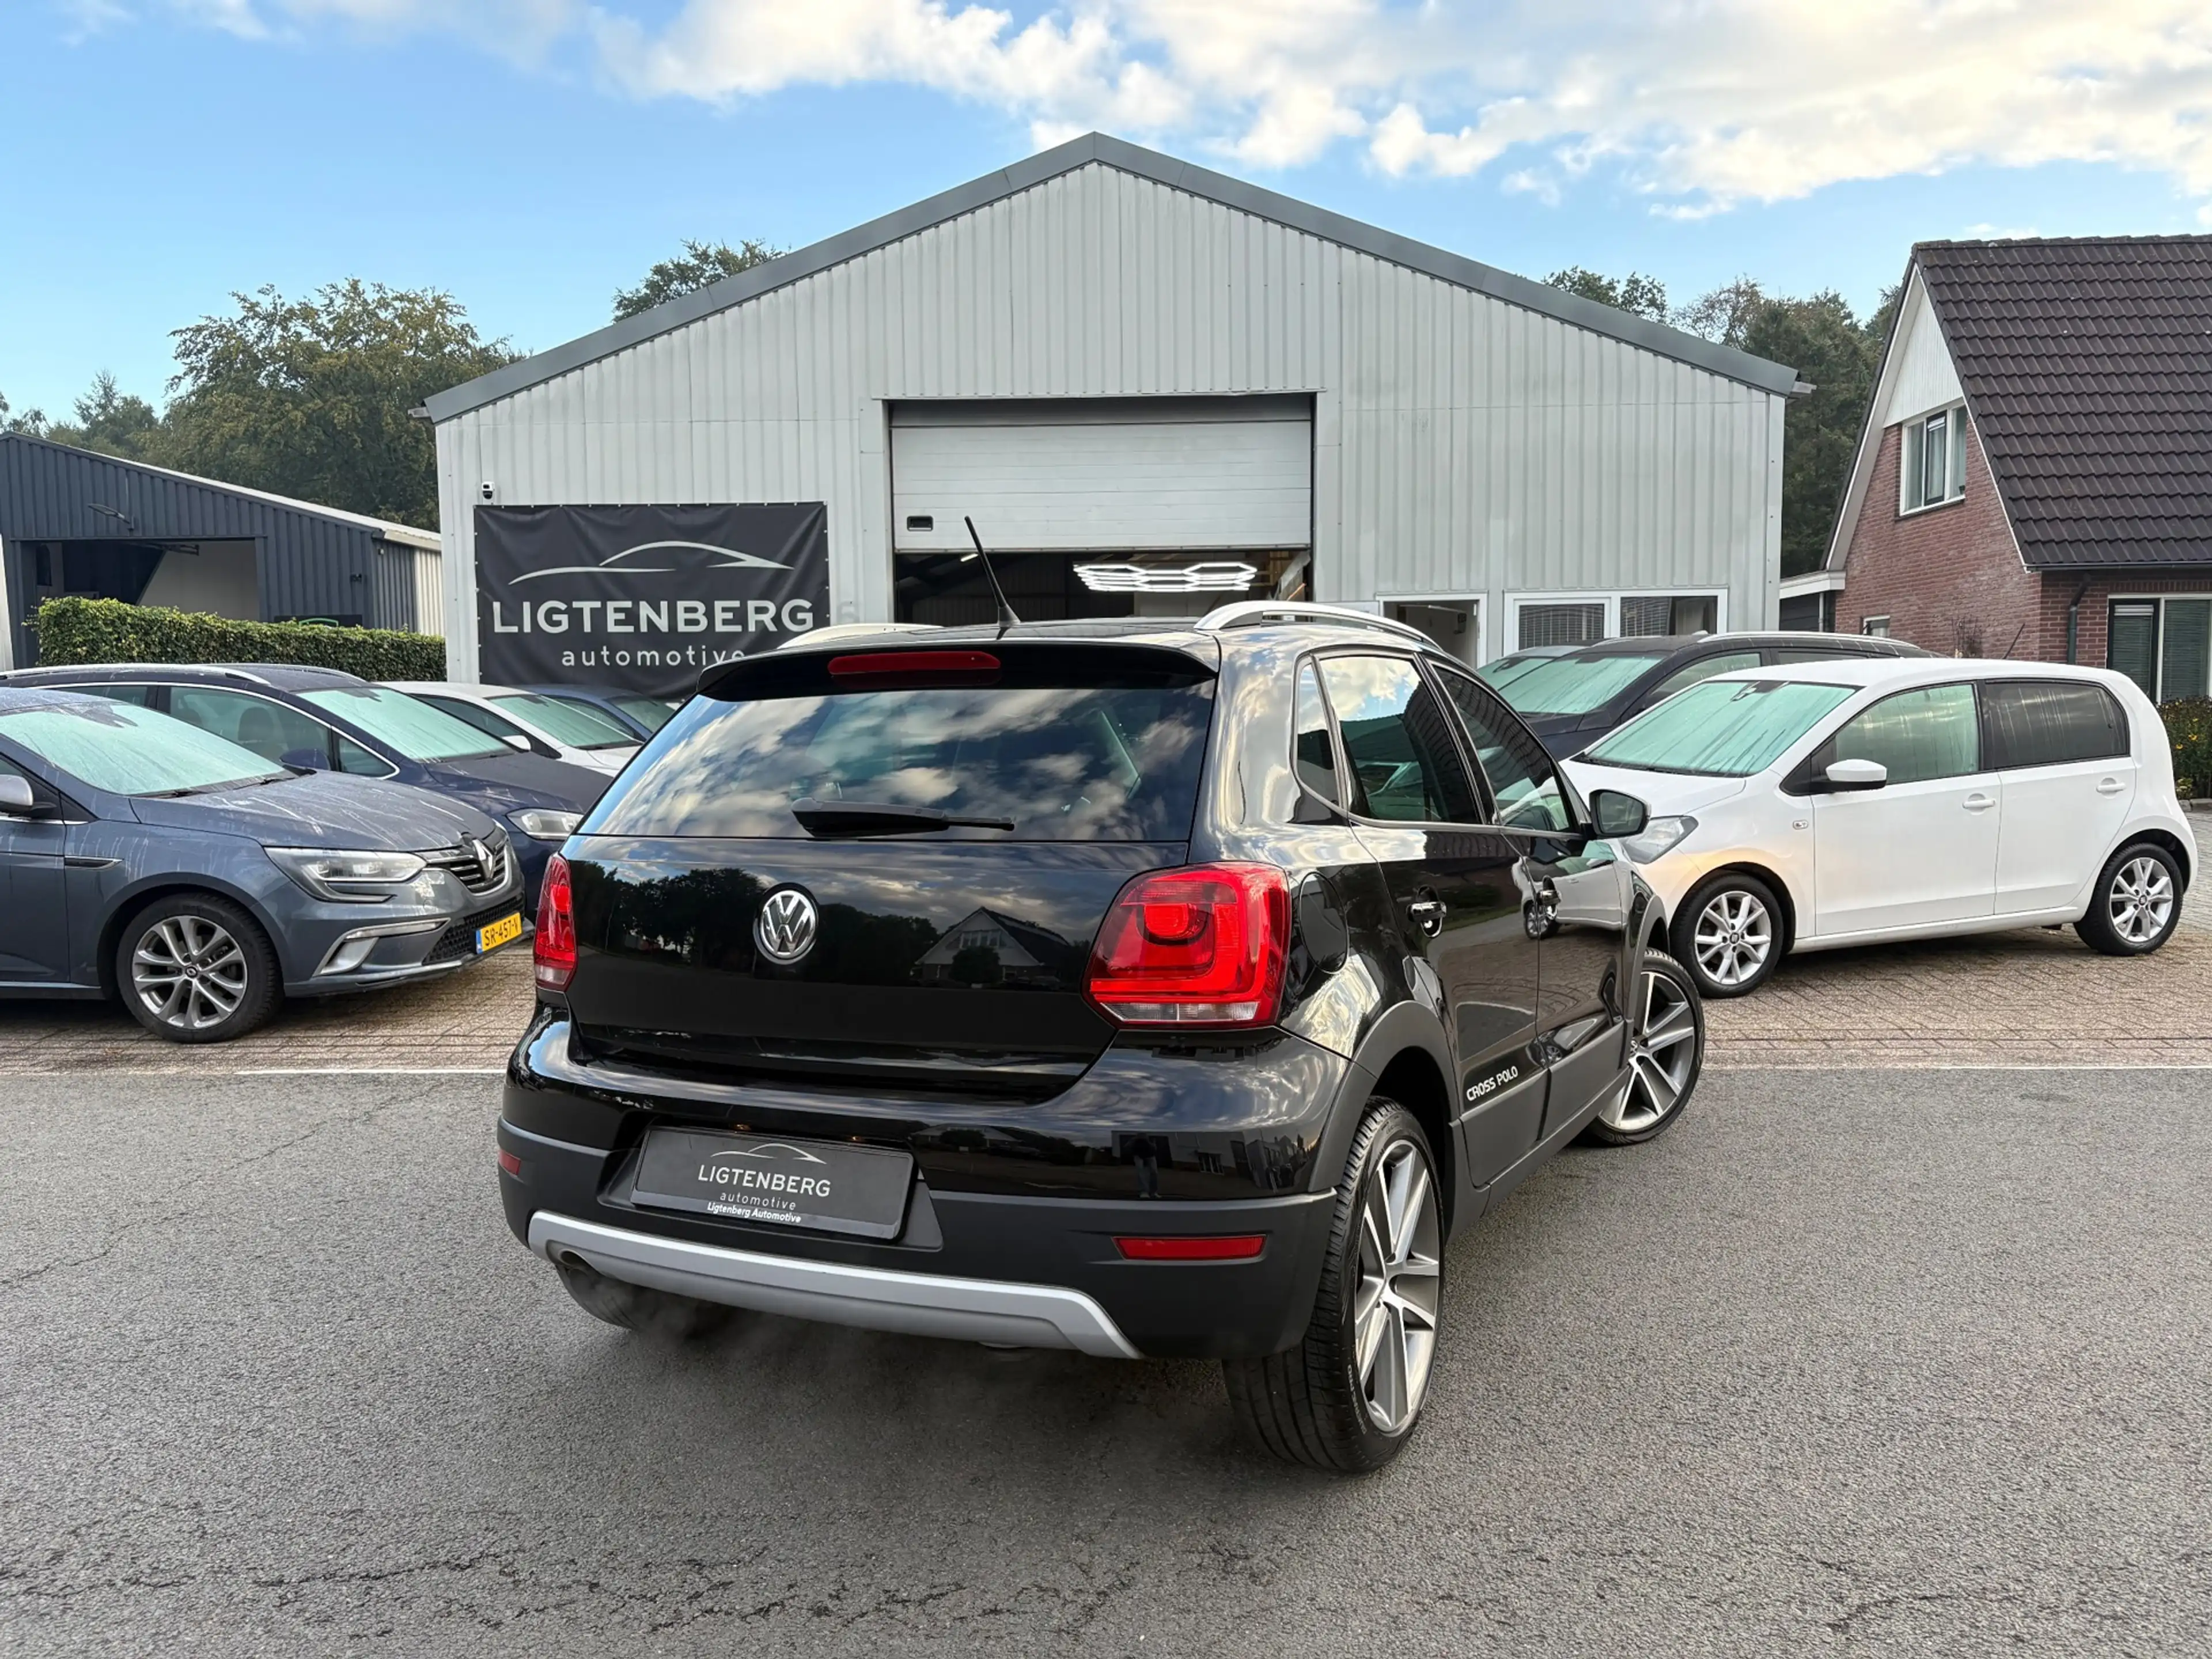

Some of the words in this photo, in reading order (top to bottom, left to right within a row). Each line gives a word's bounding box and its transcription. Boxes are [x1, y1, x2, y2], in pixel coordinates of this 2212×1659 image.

[493, 599, 813, 632] LIGTENBERG
[1467, 1077, 1496, 1101] CROSS
[1497, 1066, 1518, 1085] POLO
[698, 1165, 831, 1196] LIGTENBERG
[707, 1202, 750, 1217] Ligtenberg
[751, 1208, 801, 1223] Automotive
[720, 1192, 796, 1210] automotive
